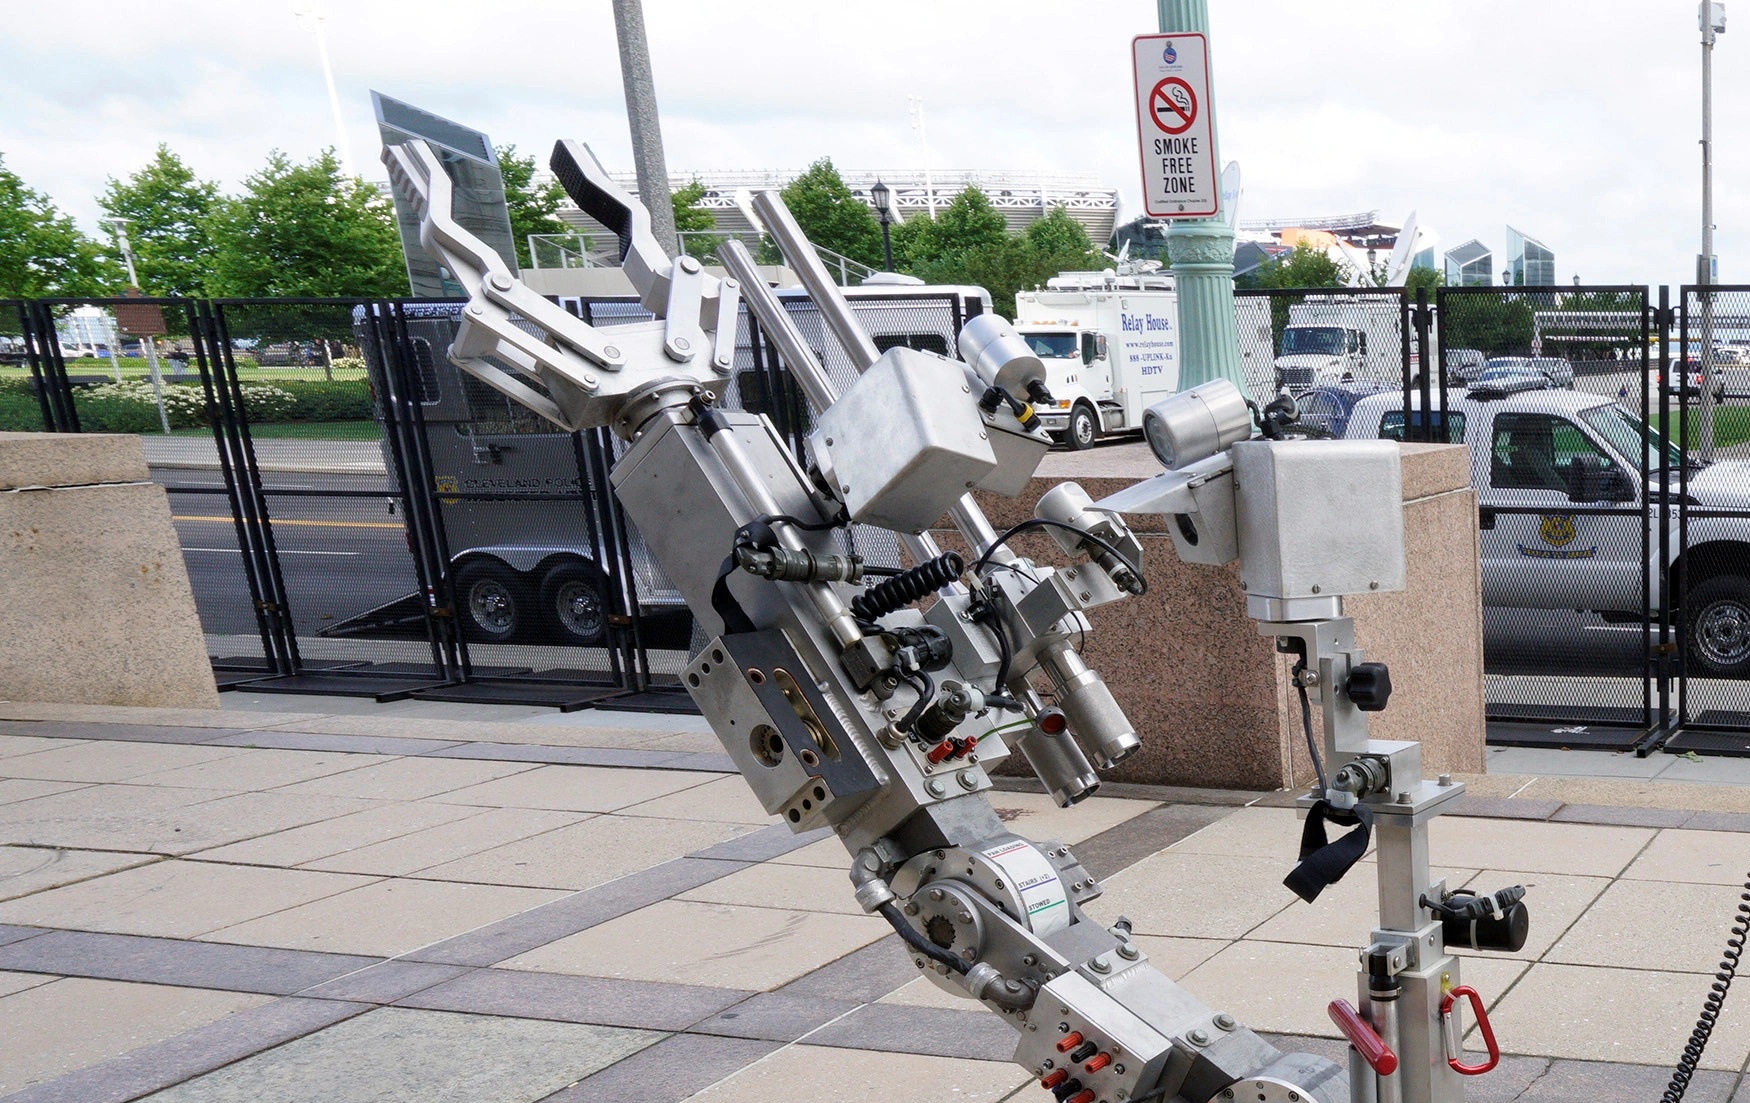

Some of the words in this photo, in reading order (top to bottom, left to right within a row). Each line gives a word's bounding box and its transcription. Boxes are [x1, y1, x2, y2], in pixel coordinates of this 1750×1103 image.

[1154, 137, 1198, 155] SMOKE
[1162, 157, 1193, 174] FREE
[1163, 176, 1196, 193] ZONE
[1121, 313, 1143, 335] Relay
[1145, 314, 1169, 331] House
[1141, 366, 1163, 375] HDTV
[465, 478, 540, 488] CLEVELAND
[545, 478, 591, 488] POLIC
[1018, 878, 1038, 889] STAIRS
[1039, 873, 1051, 882] (+2)
[1028, 899, 1051, 911] STOWED
